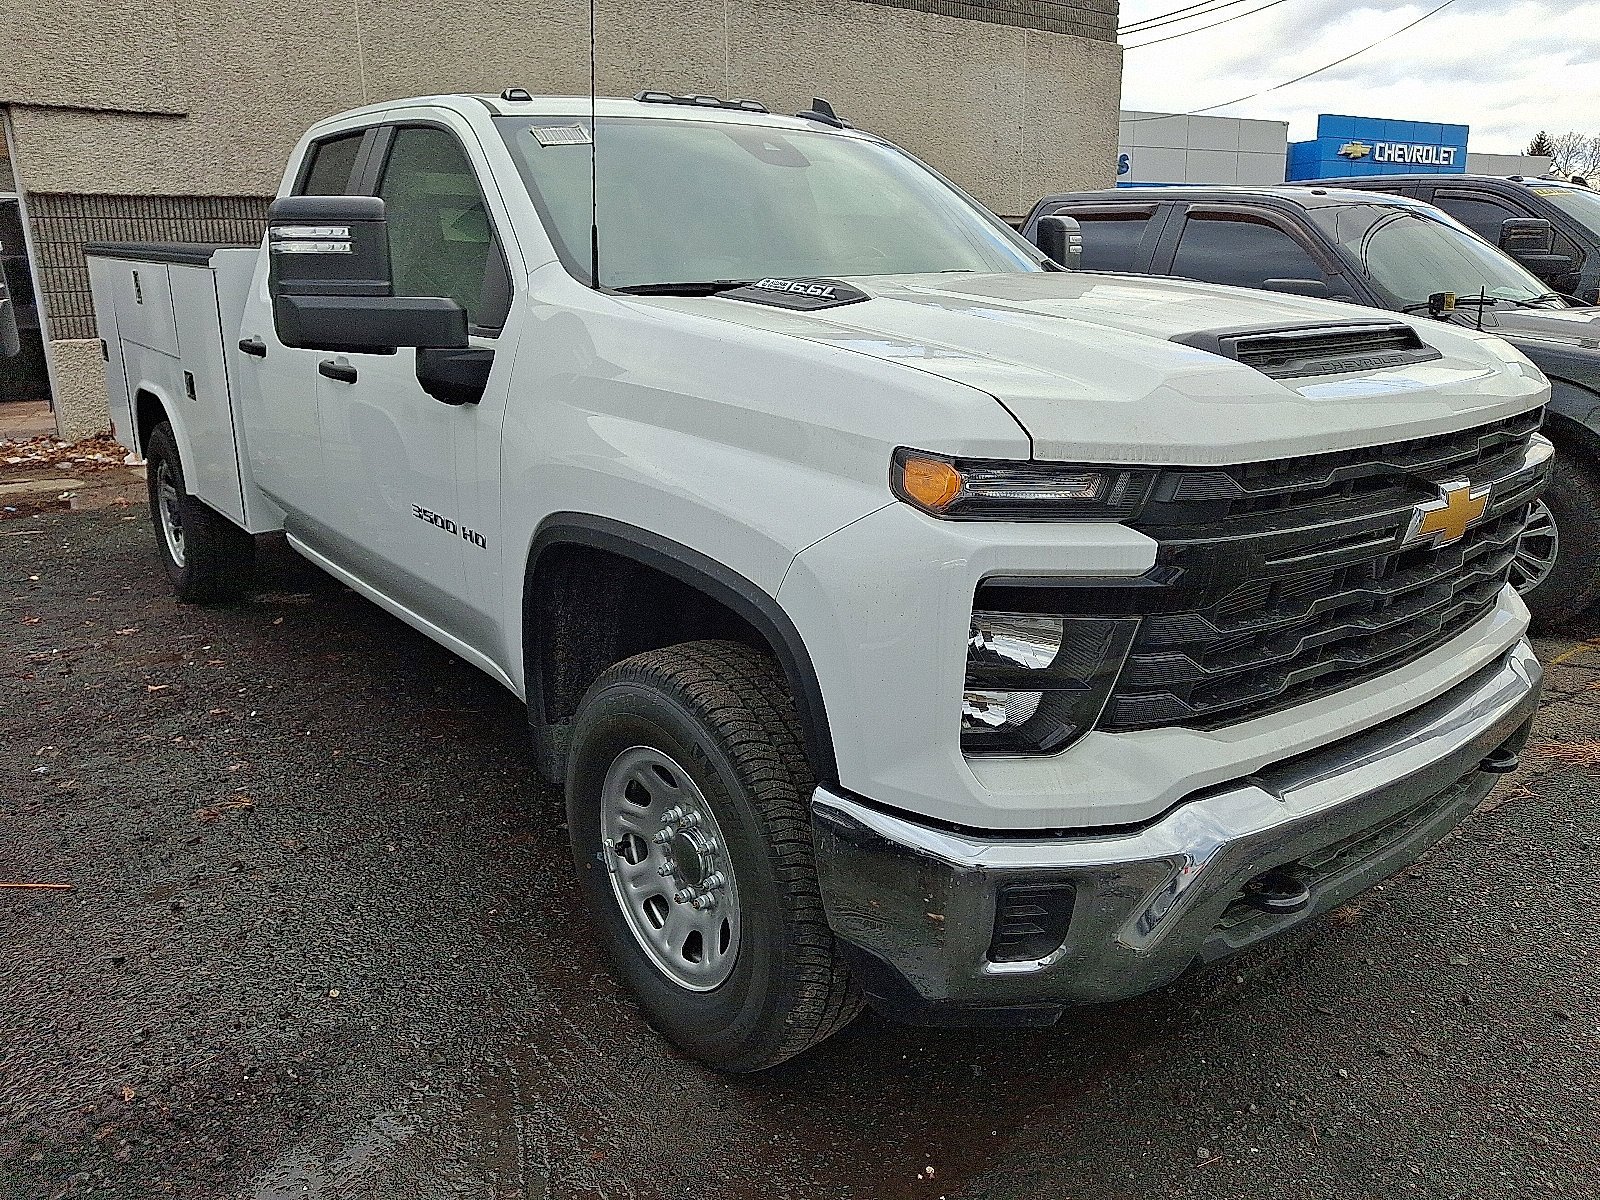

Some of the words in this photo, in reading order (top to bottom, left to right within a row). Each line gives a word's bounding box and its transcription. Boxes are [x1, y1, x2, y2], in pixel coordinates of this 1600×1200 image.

[1375, 143, 1457, 165] CHEVROLET
[788, 282, 836, 299] 6.6L
[1321, 356, 1403, 372] CHEVROLET
[411, 503, 458, 535] 3500
[461, 525, 487, 550] HD
